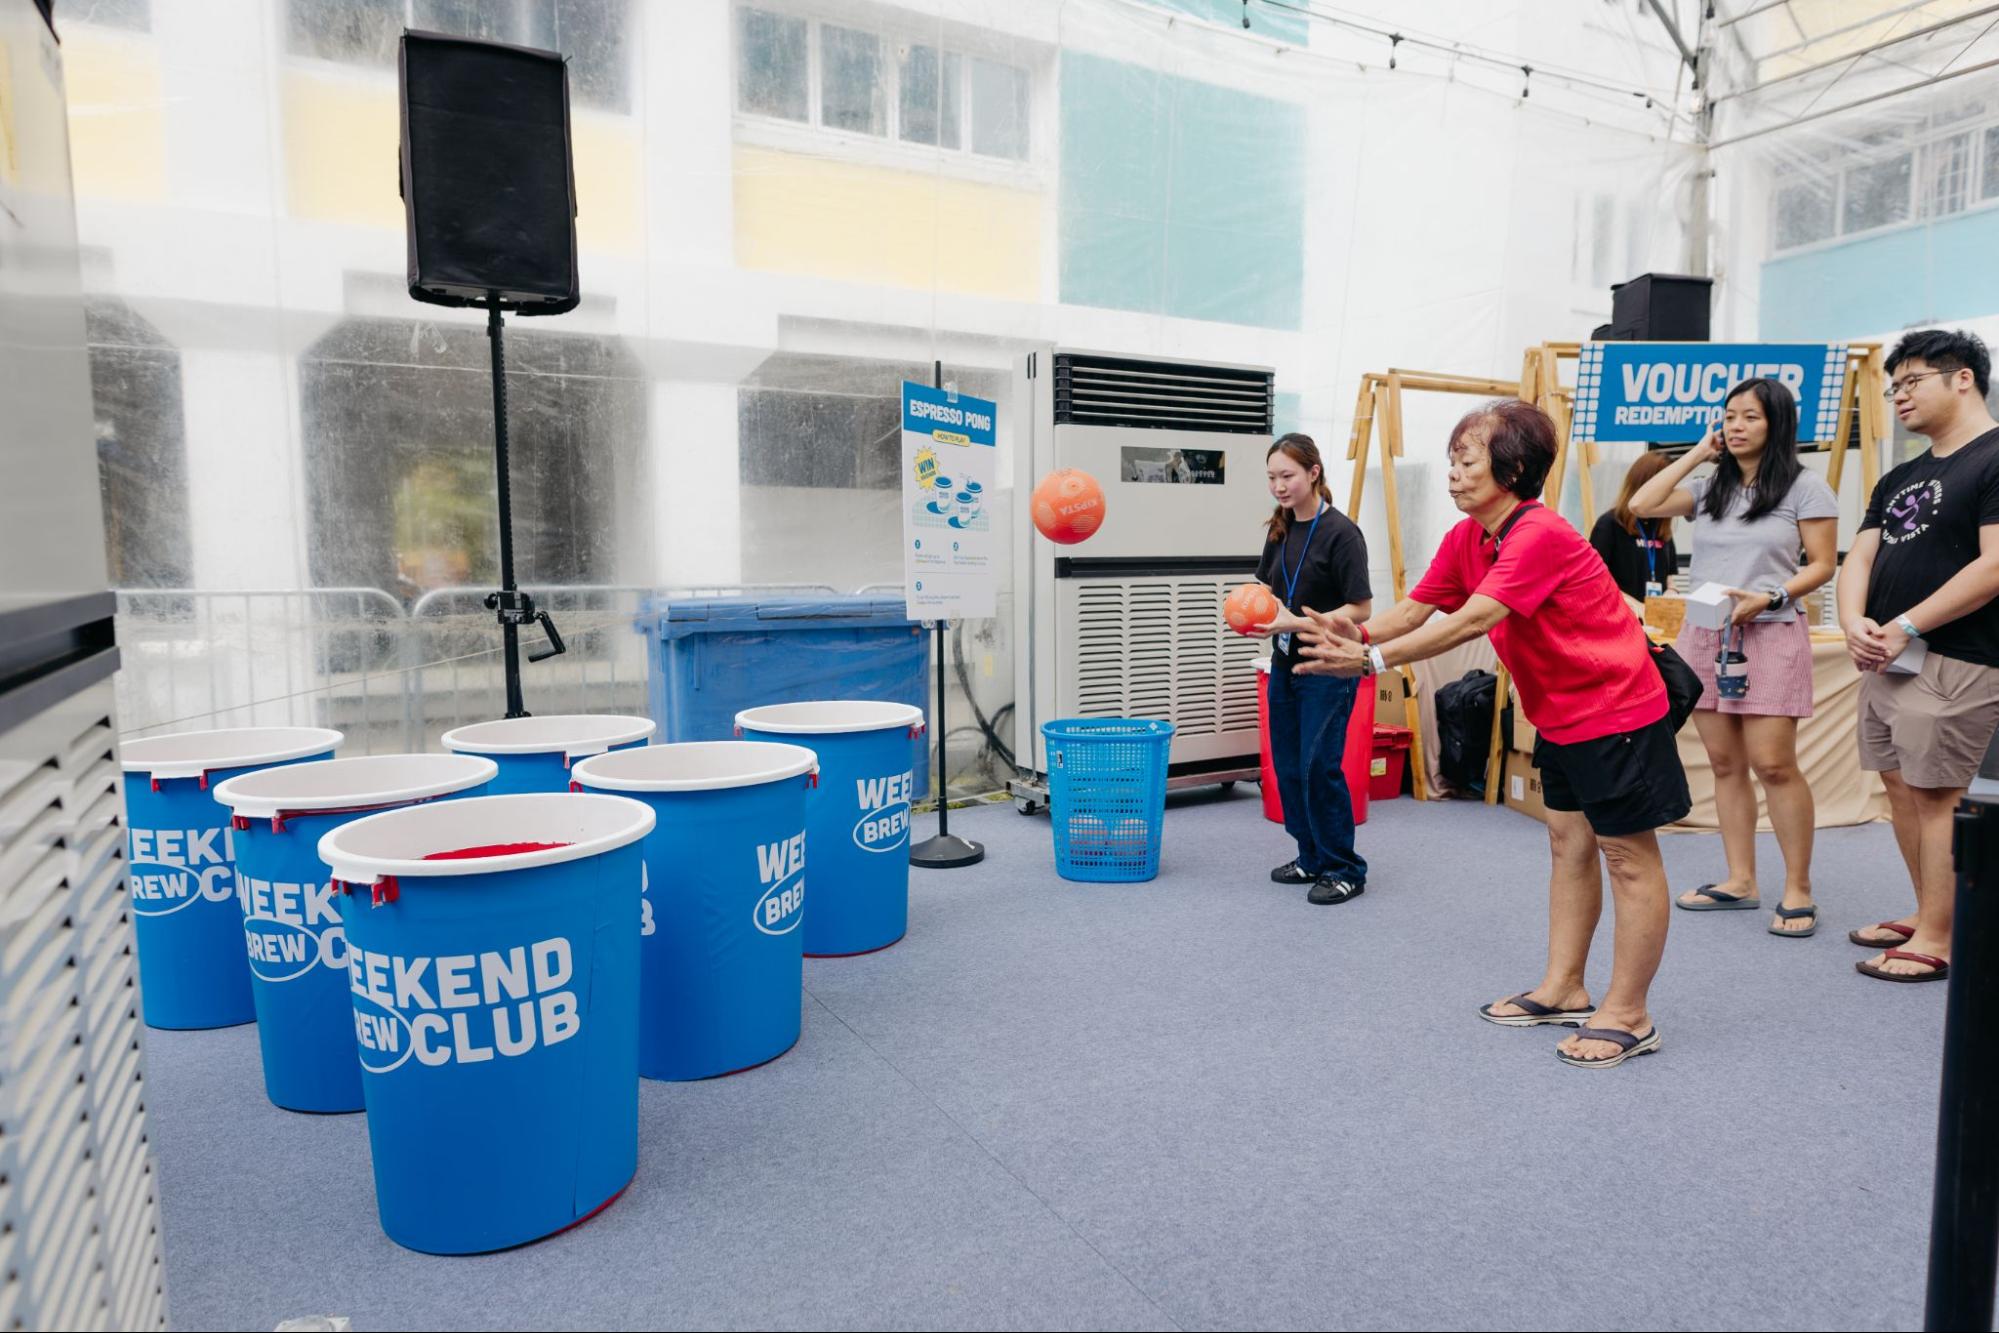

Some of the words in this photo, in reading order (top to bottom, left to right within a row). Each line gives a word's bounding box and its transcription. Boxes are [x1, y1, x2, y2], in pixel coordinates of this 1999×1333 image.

[910, 399, 963, 426] ESPRESSO
[965, 411, 991, 431] PONG
[1615, 406, 1726, 425] REDEMPTIO
[918, 457, 935, 475] WIN
[1900, 522, 1930, 542] VISTA
[856, 768, 913, 810] WEE
[128, 827, 236, 866] EEK
[765, 875, 805, 925] BRE
[411, 991, 581, 1067] CLUB
